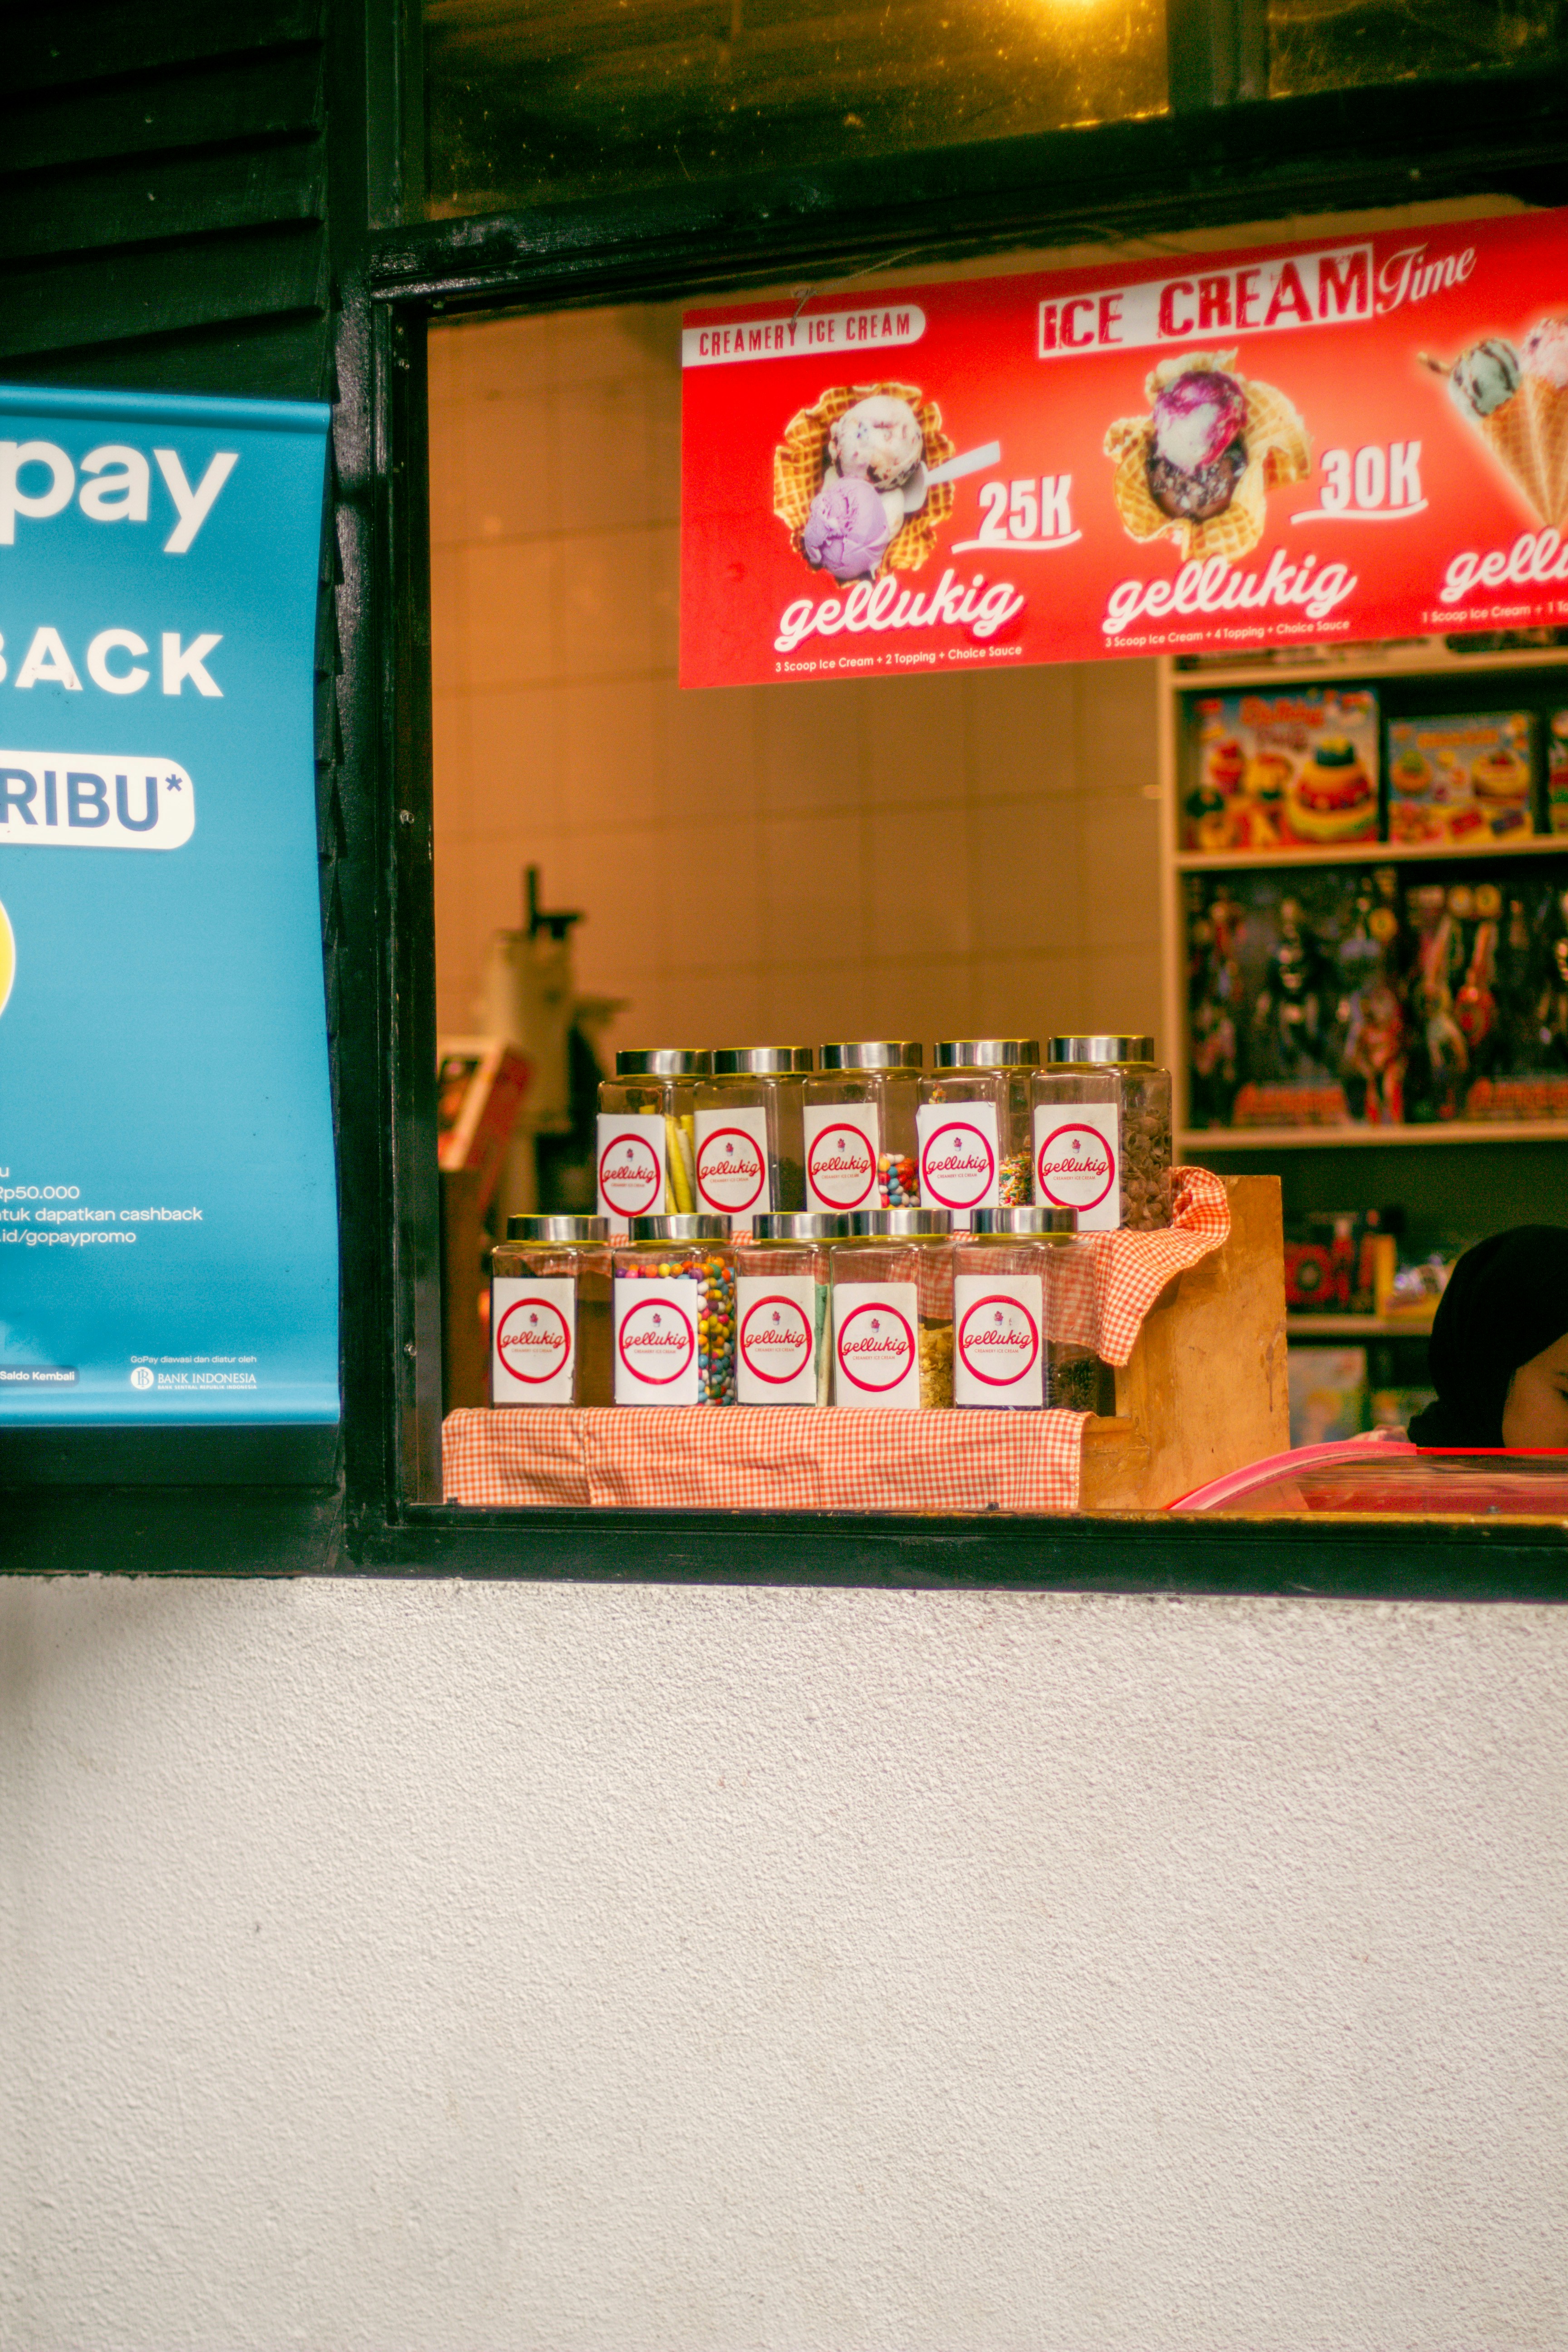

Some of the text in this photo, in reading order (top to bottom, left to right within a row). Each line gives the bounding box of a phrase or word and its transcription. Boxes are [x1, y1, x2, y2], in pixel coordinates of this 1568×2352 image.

[1374, 242, 1478, 314] Time
[1043, 251, 1368, 351] ICE CREAM
[699, 312, 910, 357] CREAMERY ICE CREAM
[1321, 441, 1422, 510] 30K
[0, 441, 239, 553] pay
[979, 475, 1072, 541] 25K
[1102, 549, 1357, 634] gellukig
[774, 569, 1024, 652] gellukig
[1431, 611, 1468, 622] Scoop
[1470, 609, 1488, 619] Ice
[1491, 606, 1531, 617] Cream
[1105, 637, 1111, 647] 3
[1114, 635, 1146, 647] Scoop
[1149, 634, 1165, 644] Ice
[1168, 630, 1203, 642] Cream
[1215, 629, 1221, 639] 4
[1223, 626, 1265, 639] Topping
[1276, 622, 1314, 635] Choice
[1317, 620, 1350, 631] Sauce
[0, 627, 224, 697] ACK
[775, 662, 781, 672] 3
[784, 660, 817, 672] Scoop
[819, 659, 836, 669] Ice
[838, 656, 873, 668] Cream
[886, 654, 892, 664] 2
[894, 651, 936, 665] Topping
[948, 647, 986, 660] Choice
[989, 645, 1022, 657] Sauce
[603, 1165, 657, 1183] gellukig
[699, 1159, 761, 1179] gellukig
[811, 1155, 872, 1176] gellukig
[926, 1154, 990, 1175] gellukig
[1042, 1157, 1110, 1176] gellukig
[0, 1207, 203, 1224] tuk dapatkan cashback
[500, 1330, 567, 1348] gellukig
[623, 1331, 690, 1349] gellukig
[744, 1329, 807, 1348] gellukig
[842, 1336, 909, 1356] gellukig
[963, 1330, 1033, 1349] gellukig
[131, 1356, 158, 1364] GoPay
[0, 1371, 75, 1381] Saldo Kembali
[158, 1373, 257, 1384] BANK INDONESIA
